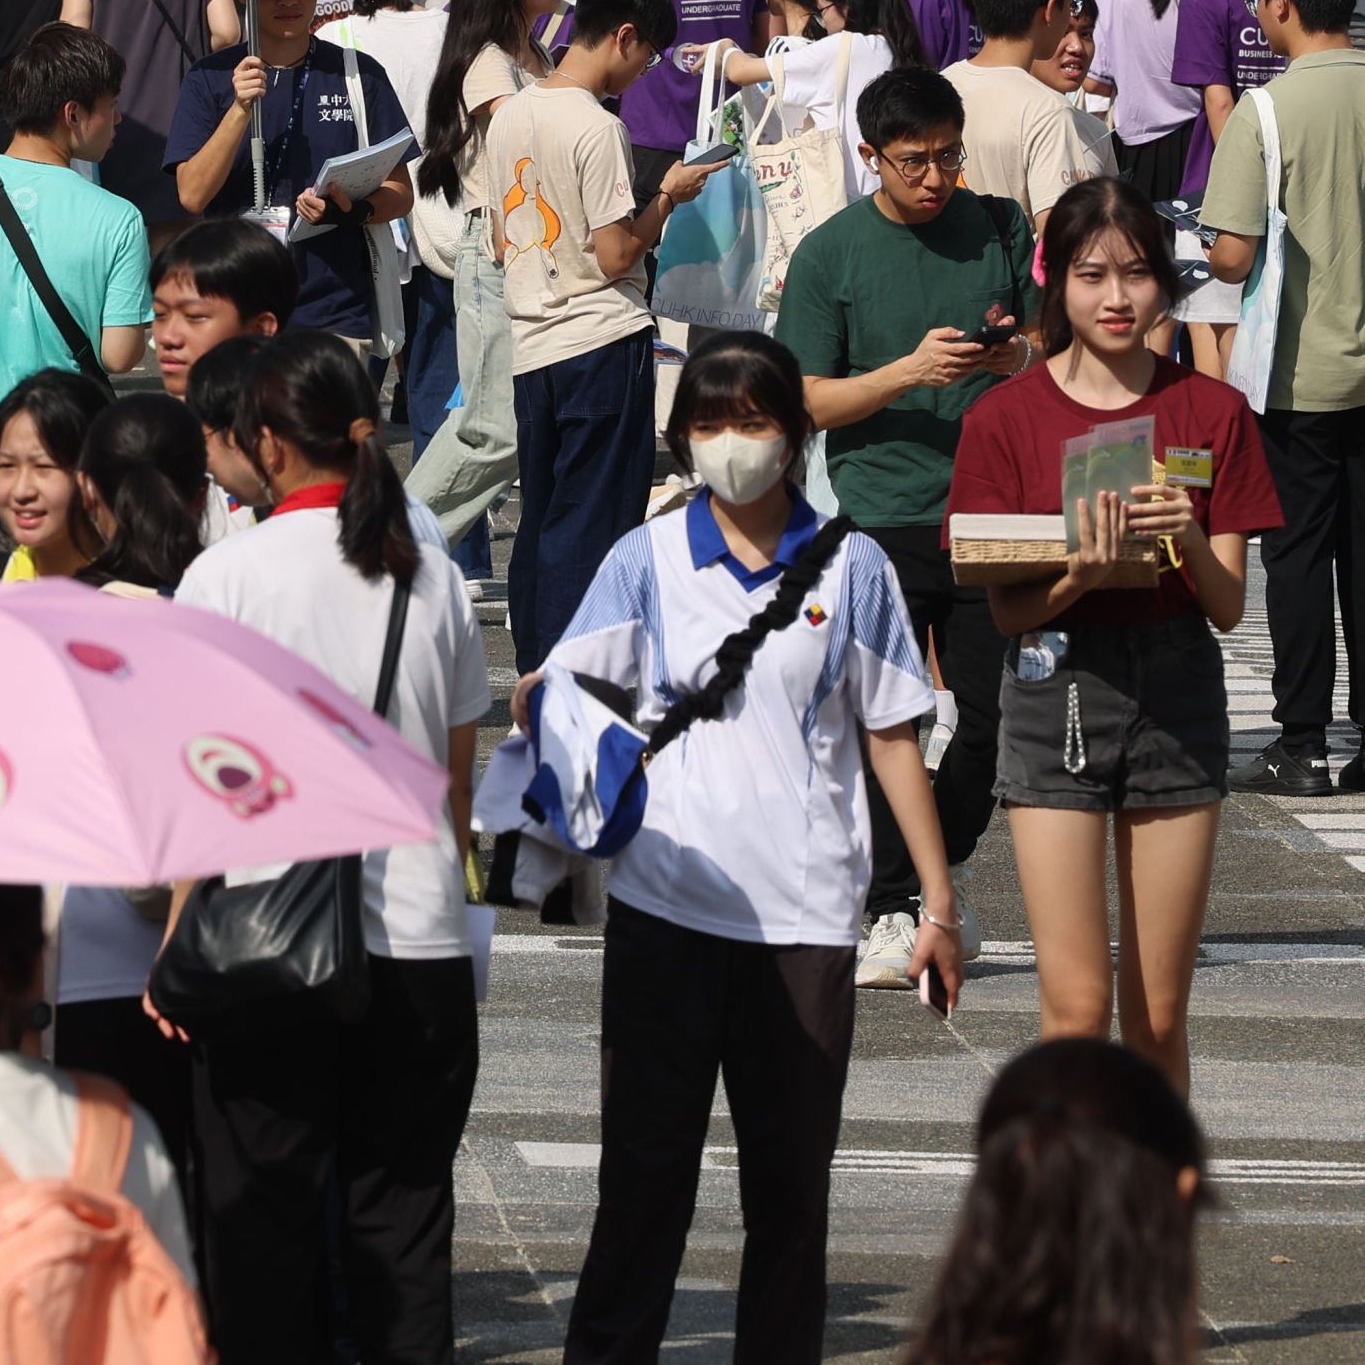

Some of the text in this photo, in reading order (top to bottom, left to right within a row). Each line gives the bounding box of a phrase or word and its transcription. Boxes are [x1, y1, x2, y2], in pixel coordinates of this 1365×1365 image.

[315, 0, 349, 16] GOOD
[1238, 49, 1272, 58] BUSINESS
[319, 109, 353, 122] 文學院
[650, 298, 762, 329] CUHK INFO DAY
